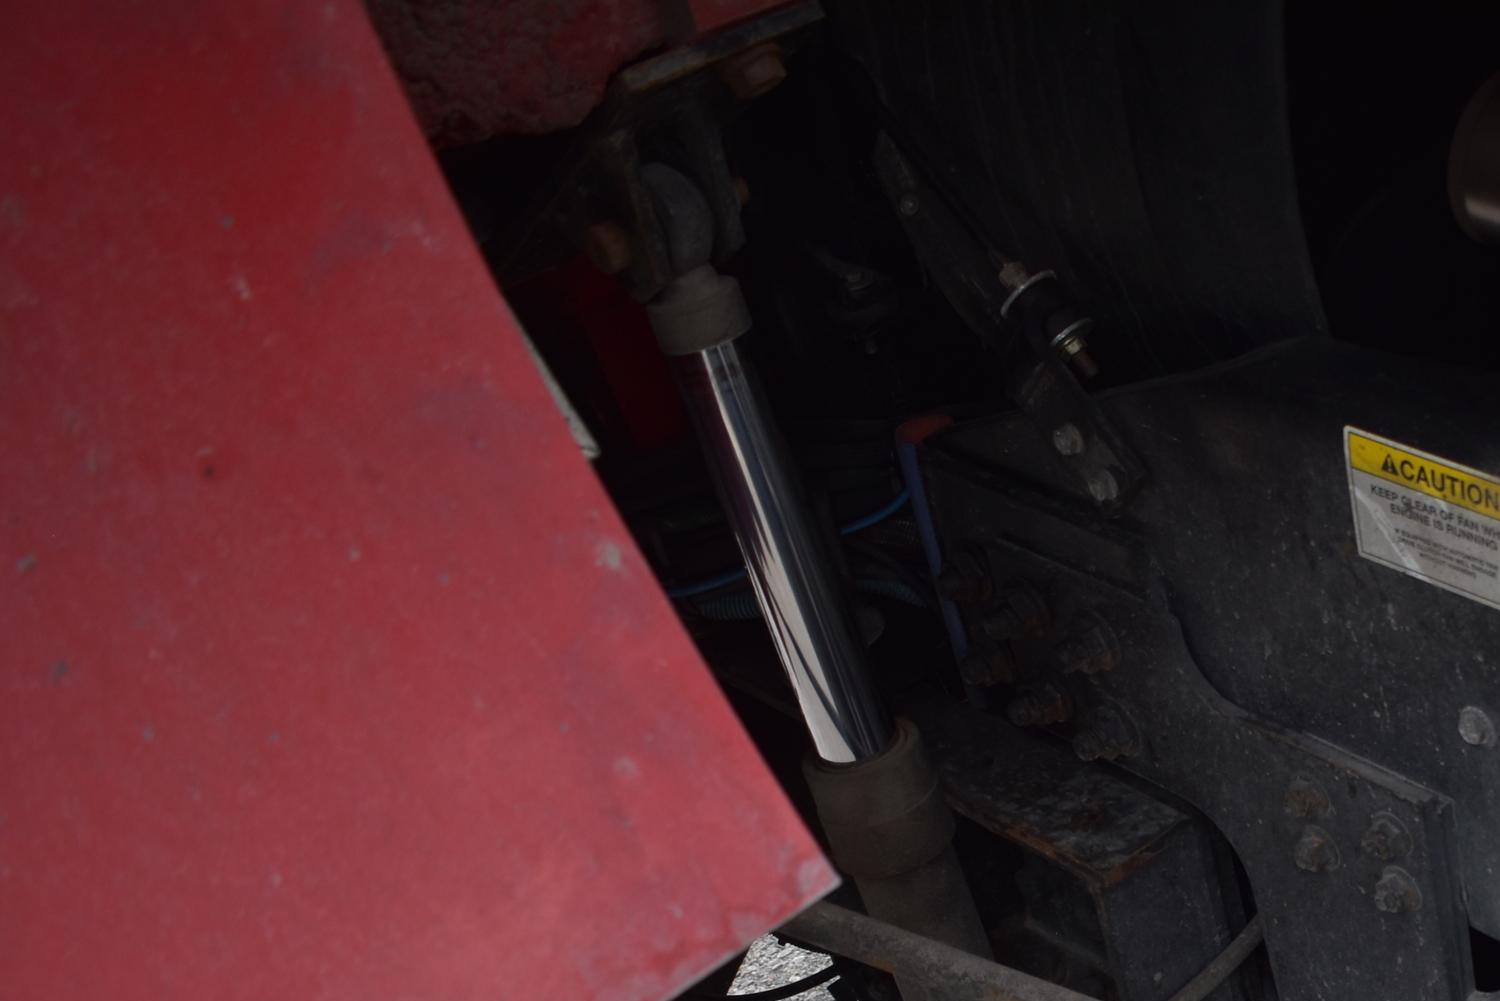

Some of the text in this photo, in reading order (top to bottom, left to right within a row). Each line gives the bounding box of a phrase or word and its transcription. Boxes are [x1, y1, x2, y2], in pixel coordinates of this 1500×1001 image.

[1371, 484, 1398, 501] KEEP
[1401, 495, 1436, 516] CLEAR
[1440, 509, 1454, 521] OF
[1458, 514, 1479, 532] FAN
[1400, 460, 1499, 511] CAUTION
[1391, 503, 1431, 528] ENGINE
[1433, 518, 1444, 532] IS
[1446, 522, 1498, 551] RUNNING
